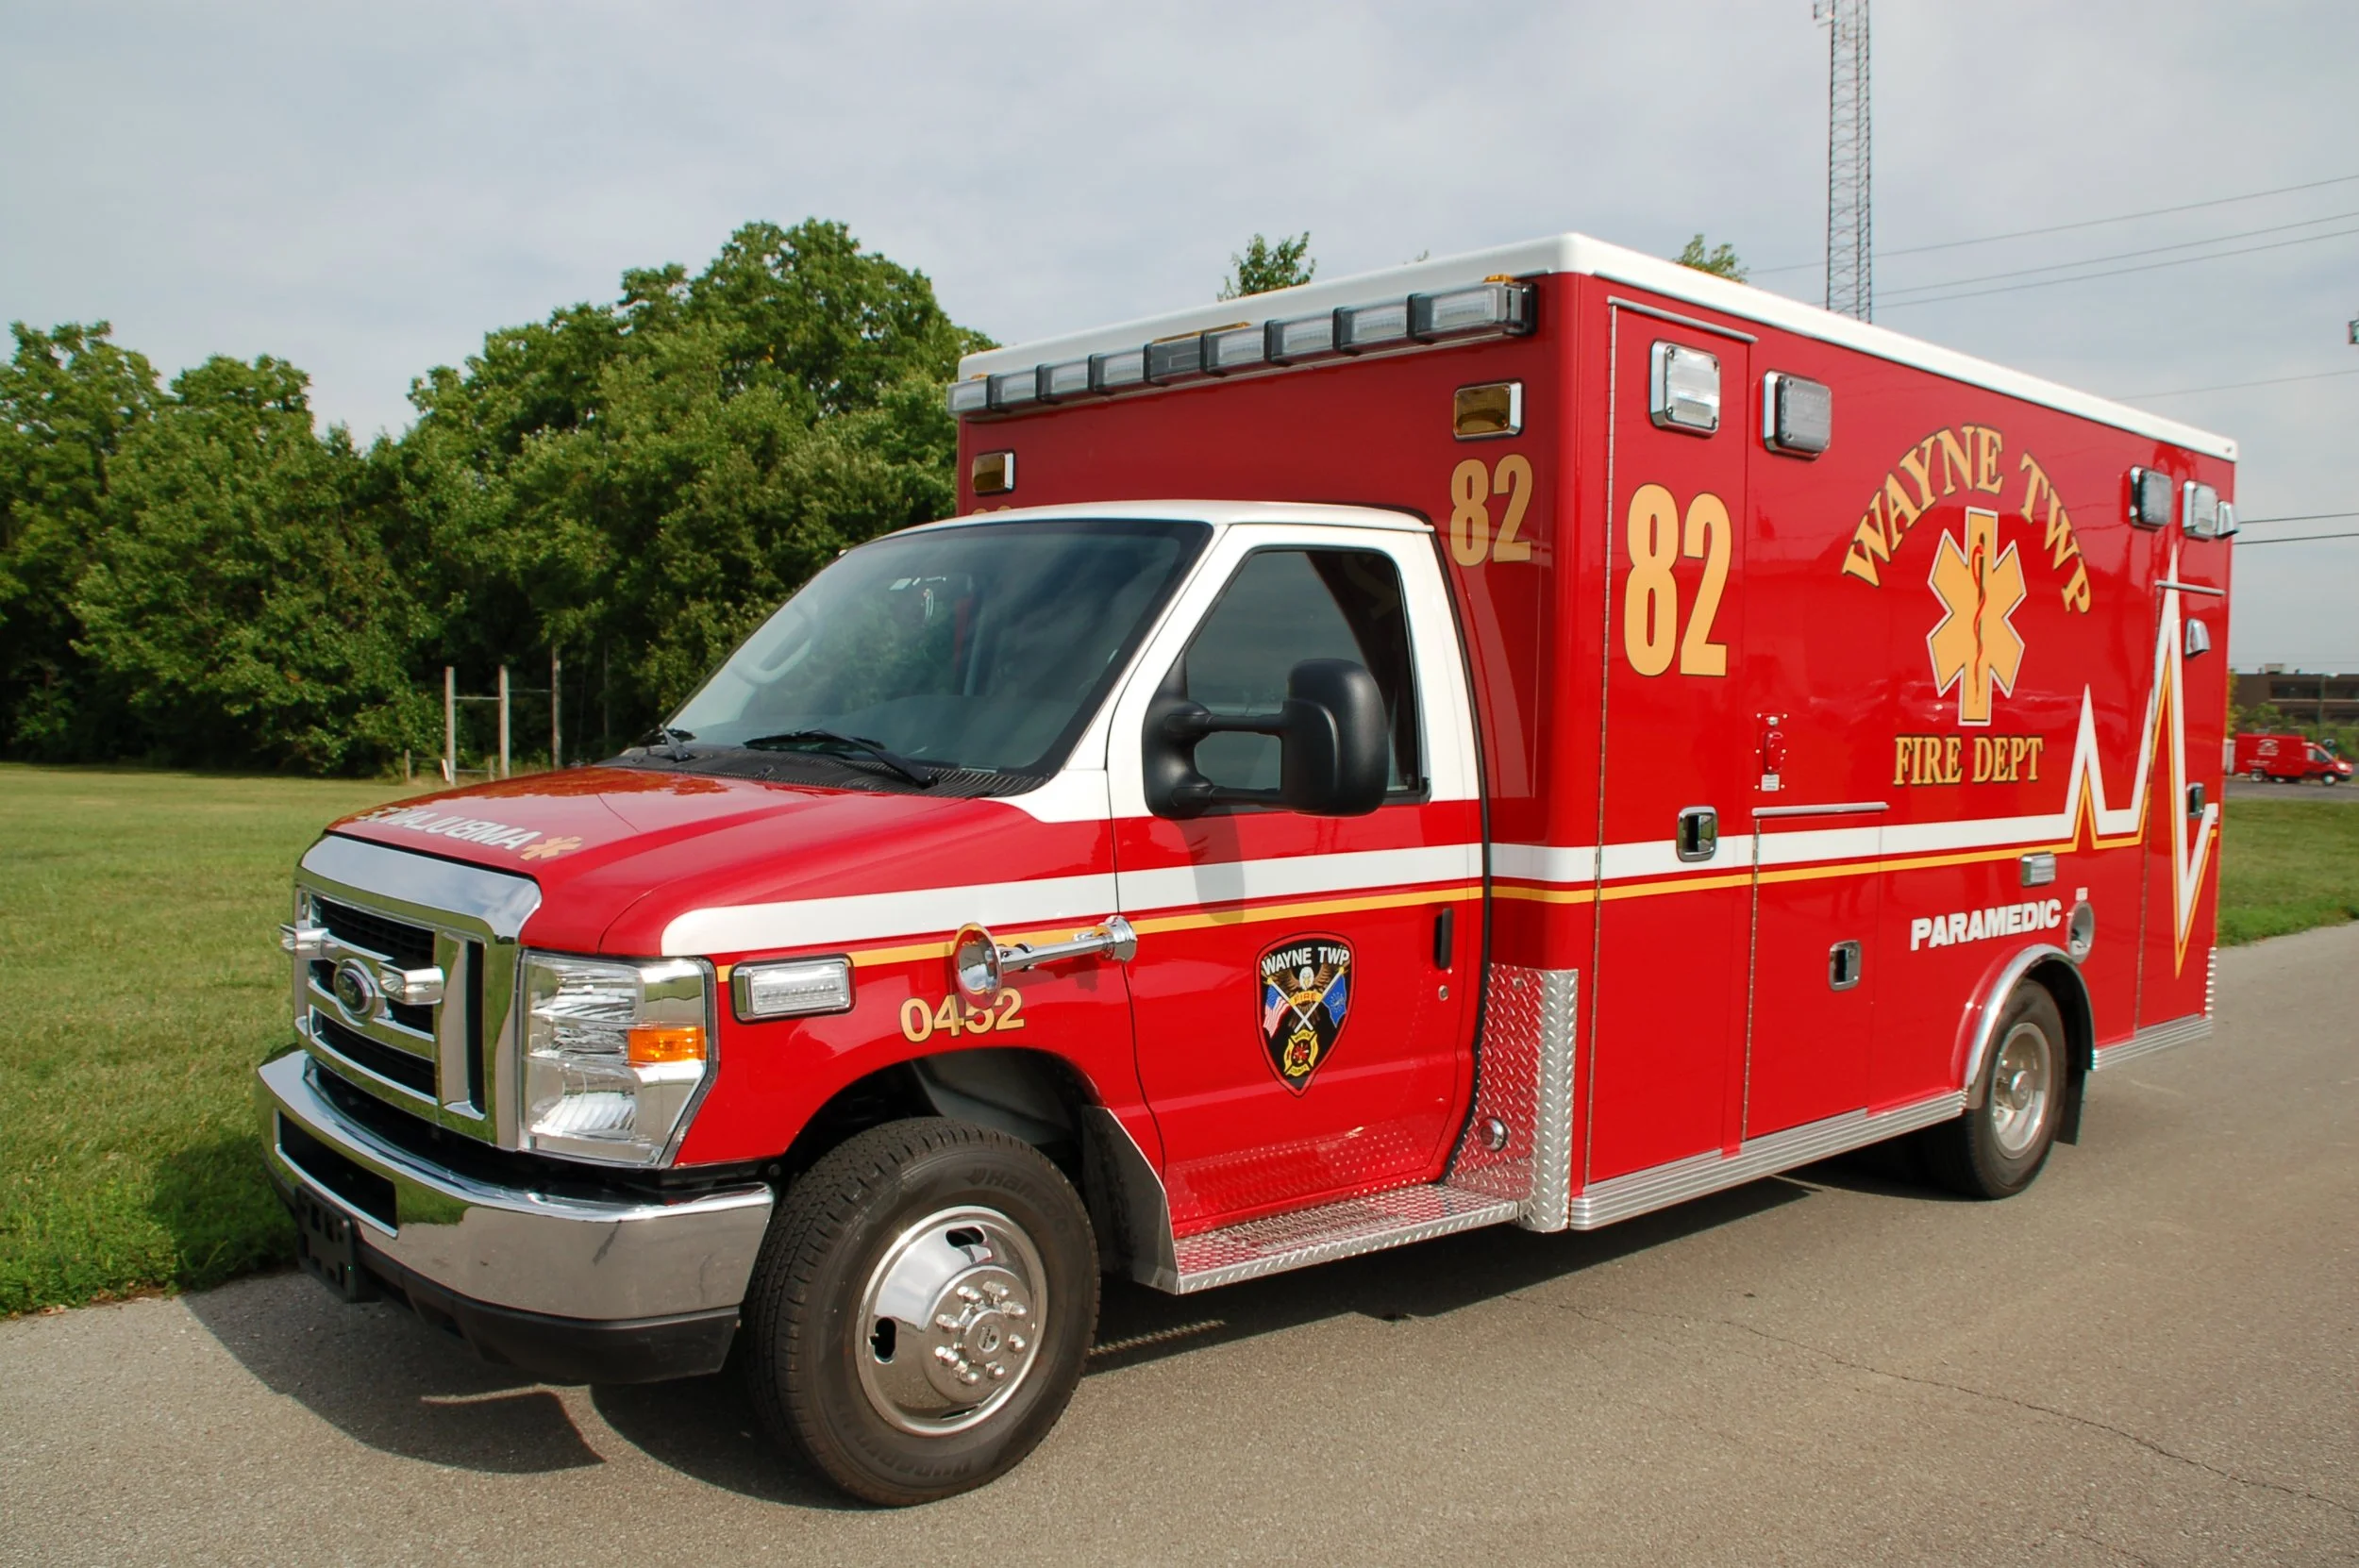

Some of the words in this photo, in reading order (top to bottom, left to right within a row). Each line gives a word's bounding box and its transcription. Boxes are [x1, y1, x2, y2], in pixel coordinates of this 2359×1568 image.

[1448, 454, 1533, 568] 82
[1840, 423, 2004, 588] WAYNE
[2017, 451, 2092, 614] TWP
[1623, 483, 1732, 677] 82
[1892, 734, 1963, 786] FIRE
[1972, 734, 2044, 784] DEPT
[1909, 897, 2063, 952] PARAMEDIC
[1262, 947, 1313, 976] WAYNE
[1318, 946, 1350, 966] TWP
[899, 986, 1026, 1043] 0452
